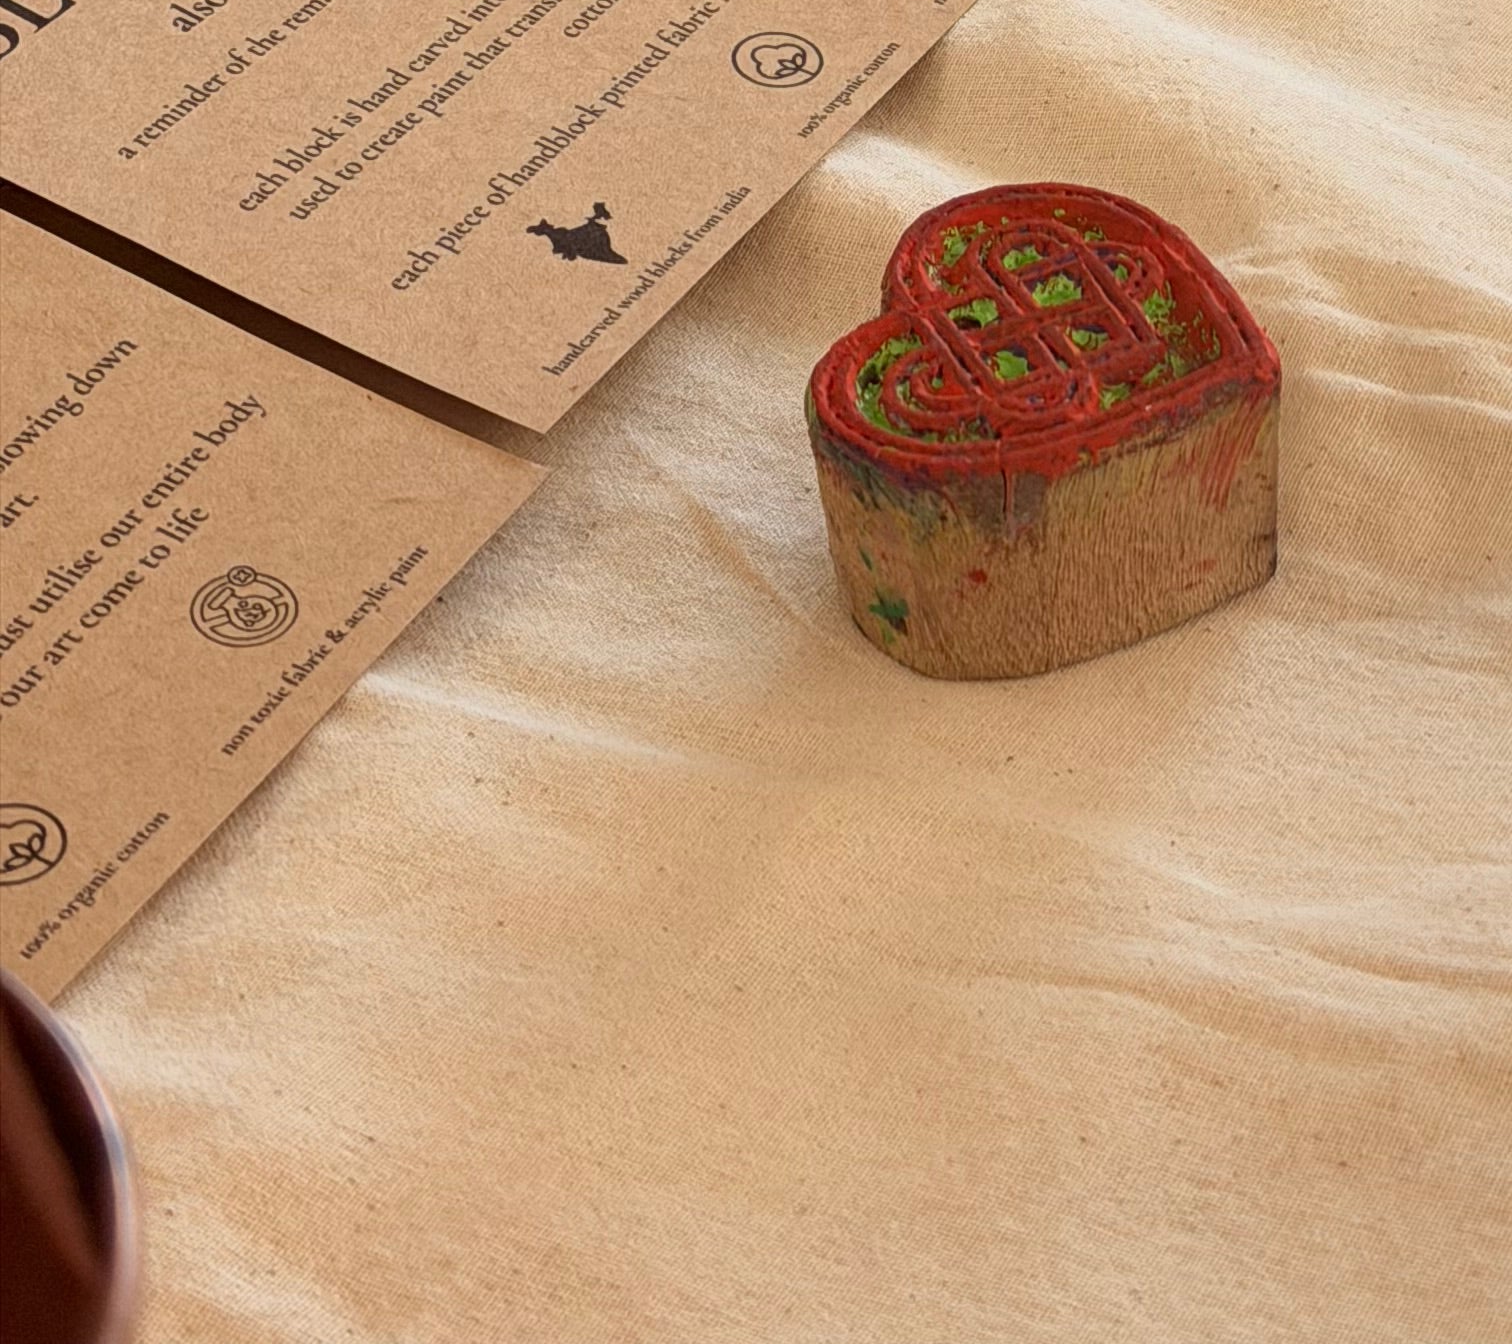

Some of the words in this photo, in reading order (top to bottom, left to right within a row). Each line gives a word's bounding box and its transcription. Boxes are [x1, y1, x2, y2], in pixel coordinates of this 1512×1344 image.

[407, 16, 474, 74] carved
[654, 0, 721, 49] fabric
[117, 145, 139, 161] a
[132, 72, 228, 149] reminder
[224, 46, 253, 76] of
[244, 28, 288, 58] the
[345, 66, 414, 114] hand
[599, 42, 672, 109] printed
[796, 112, 828, 140] 100%
[822, 74, 868, 115] organic
[862, 41, 902, 78] cotton
[272, 126, 346, 175] block
[288, 175, 342, 221] used
[333, 160, 365, 182] to
[359, 111, 424, 162] create
[416, 69, 474, 118] paint
[462, 35, 512, 72] that
[332, 111, 363, 129] is
[495, 103, 608, 188] handblock
[238, 172, 290, 213] each
[485, 176, 514, 207] of
[433, 204, 492, 257] piece
[390, 249, 442, 292] each
[541, 306, 623, 377] handcarved
[617, 274, 656, 310] wood
[643, 240, 694, 279] blocks
[682, 213, 724, 243] from
[713, 185, 752, 216] india
[0, 394, 85, 475] owing
[65, 339, 139, 397] down
[0, 615, 35, 659] ust
[28, 549, 104, 615] utilise
[99, 508, 144, 549] our
[141, 446, 211, 510] entire
[192, 394, 268, 447] body
[0, 664, 45, 708] our
[42, 629, 84, 666] art
[79, 569, 145, 630] come
[137, 543, 172, 570] to
[155, 507, 210, 544] life
[220, 724, 256, 757] non
[249, 686, 292, 725] toxic
[280, 644, 333, 688] fabric
[323, 628, 349, 645] &
[344, 582, 394, 630] acrylic
[388, 545, 429, 587] paint
[19, 920, 62, 960] 100%
[57, 861, 119, 921] organic
[115, 811, 170, 864] cotton
